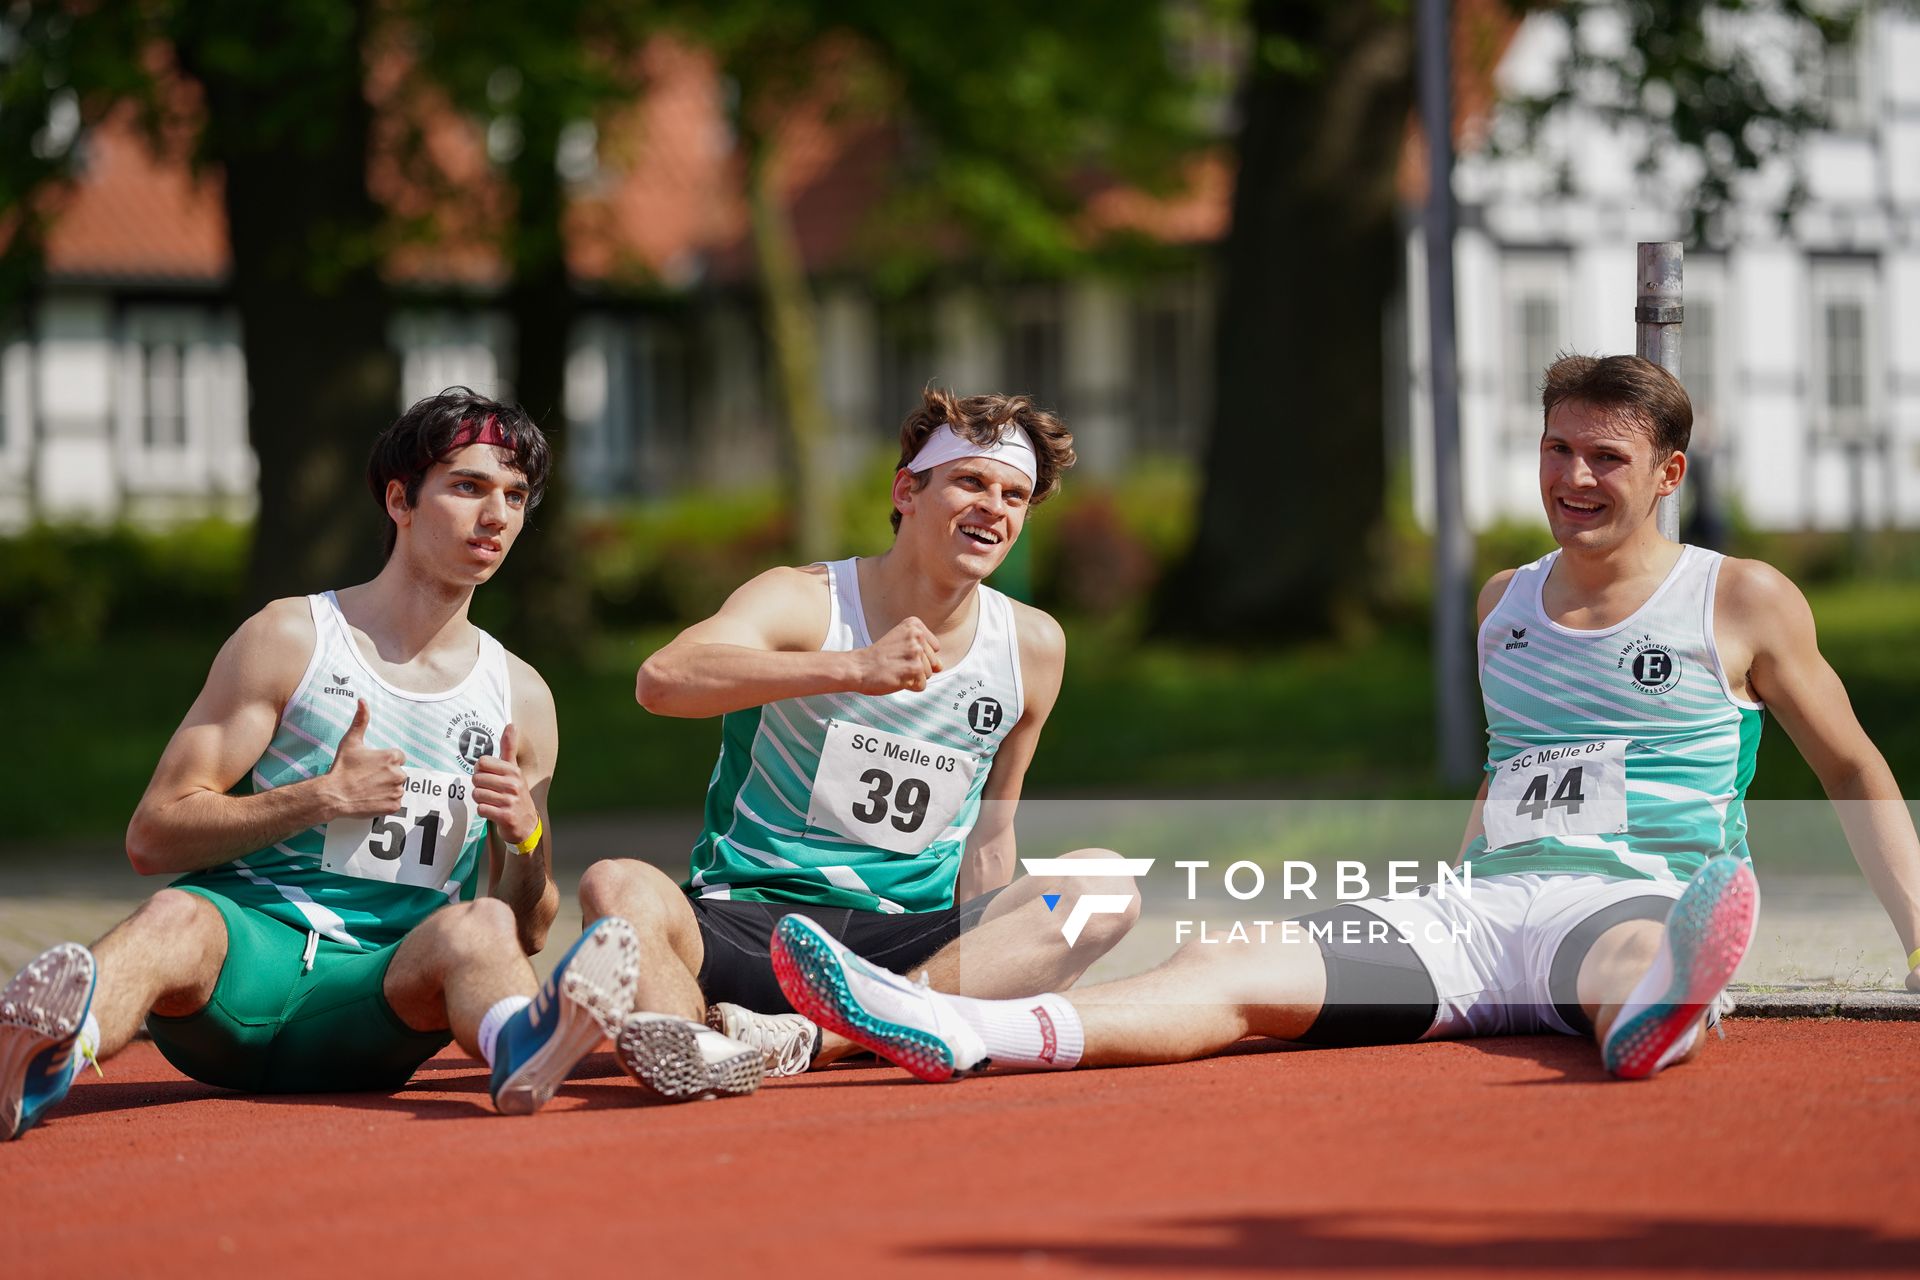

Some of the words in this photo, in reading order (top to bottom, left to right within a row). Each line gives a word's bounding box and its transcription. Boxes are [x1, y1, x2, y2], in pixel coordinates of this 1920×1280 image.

[1506, 641, 1528, 650] erima
[1620, 642, 1634, 656] 1861
[1636, 644, 1671, 653] Eintracht
[1640, 653, 1665, 682] E
[324, 686, 354, 698] erima
[1630, 680, 1671, 693] Hildesheim
[450, 713, 463, 726] 1861
[974, 700, 998, 732] E
[464, 720, 494, 736] Eintracht
[852, 734, 878, 754] SC
[884, 742, 930, 767] Melle
[936, 755, 956, 772] 03
[1510, 754, 1532, 772] SC
[1537, 748, 1580, 766] Melle
[1586, 741, 1606, 754] 03
[456, 754, 474, 774] Hildes
[448, 784, 466, 800] 03
[852, 768, 931, 833] 39
[1516, 766, 1584, 820] 44
[368, 806, 440, 866] 51
